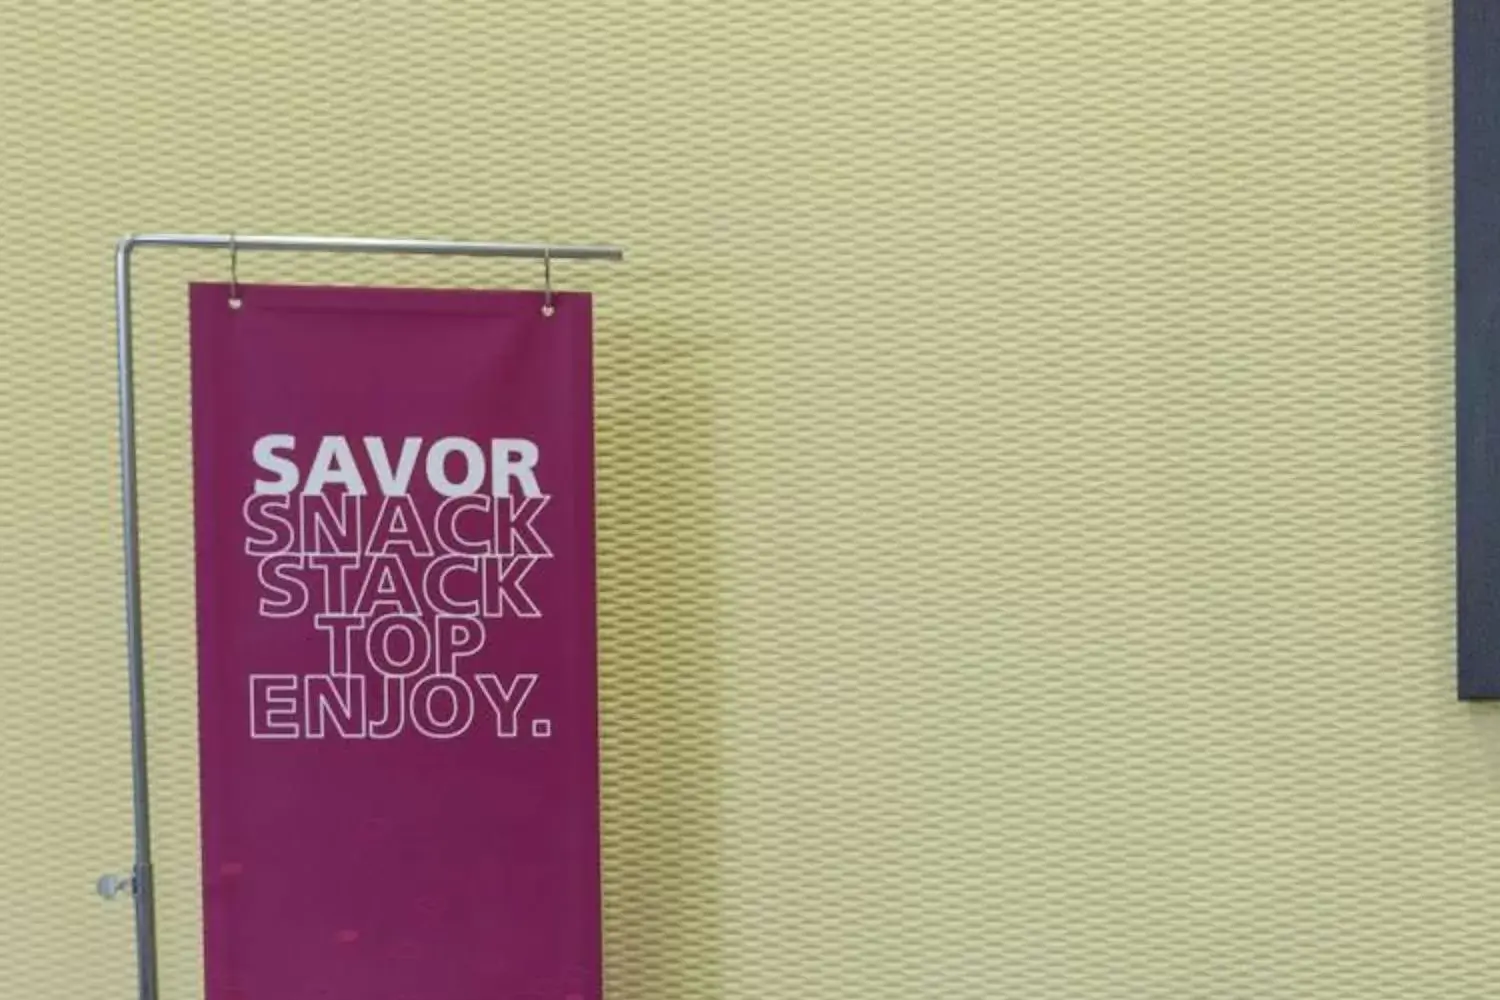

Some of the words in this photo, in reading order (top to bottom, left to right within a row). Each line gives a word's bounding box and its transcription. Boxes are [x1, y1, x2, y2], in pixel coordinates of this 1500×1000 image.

[252, 434, 543, 498] SAVOR
[243, 493, 554, 557] SNACK
[258, 554, 543, 618] STACK
[315, 614, 486, 677] TOP
[249, 674, 552, 739] ENJOY.
